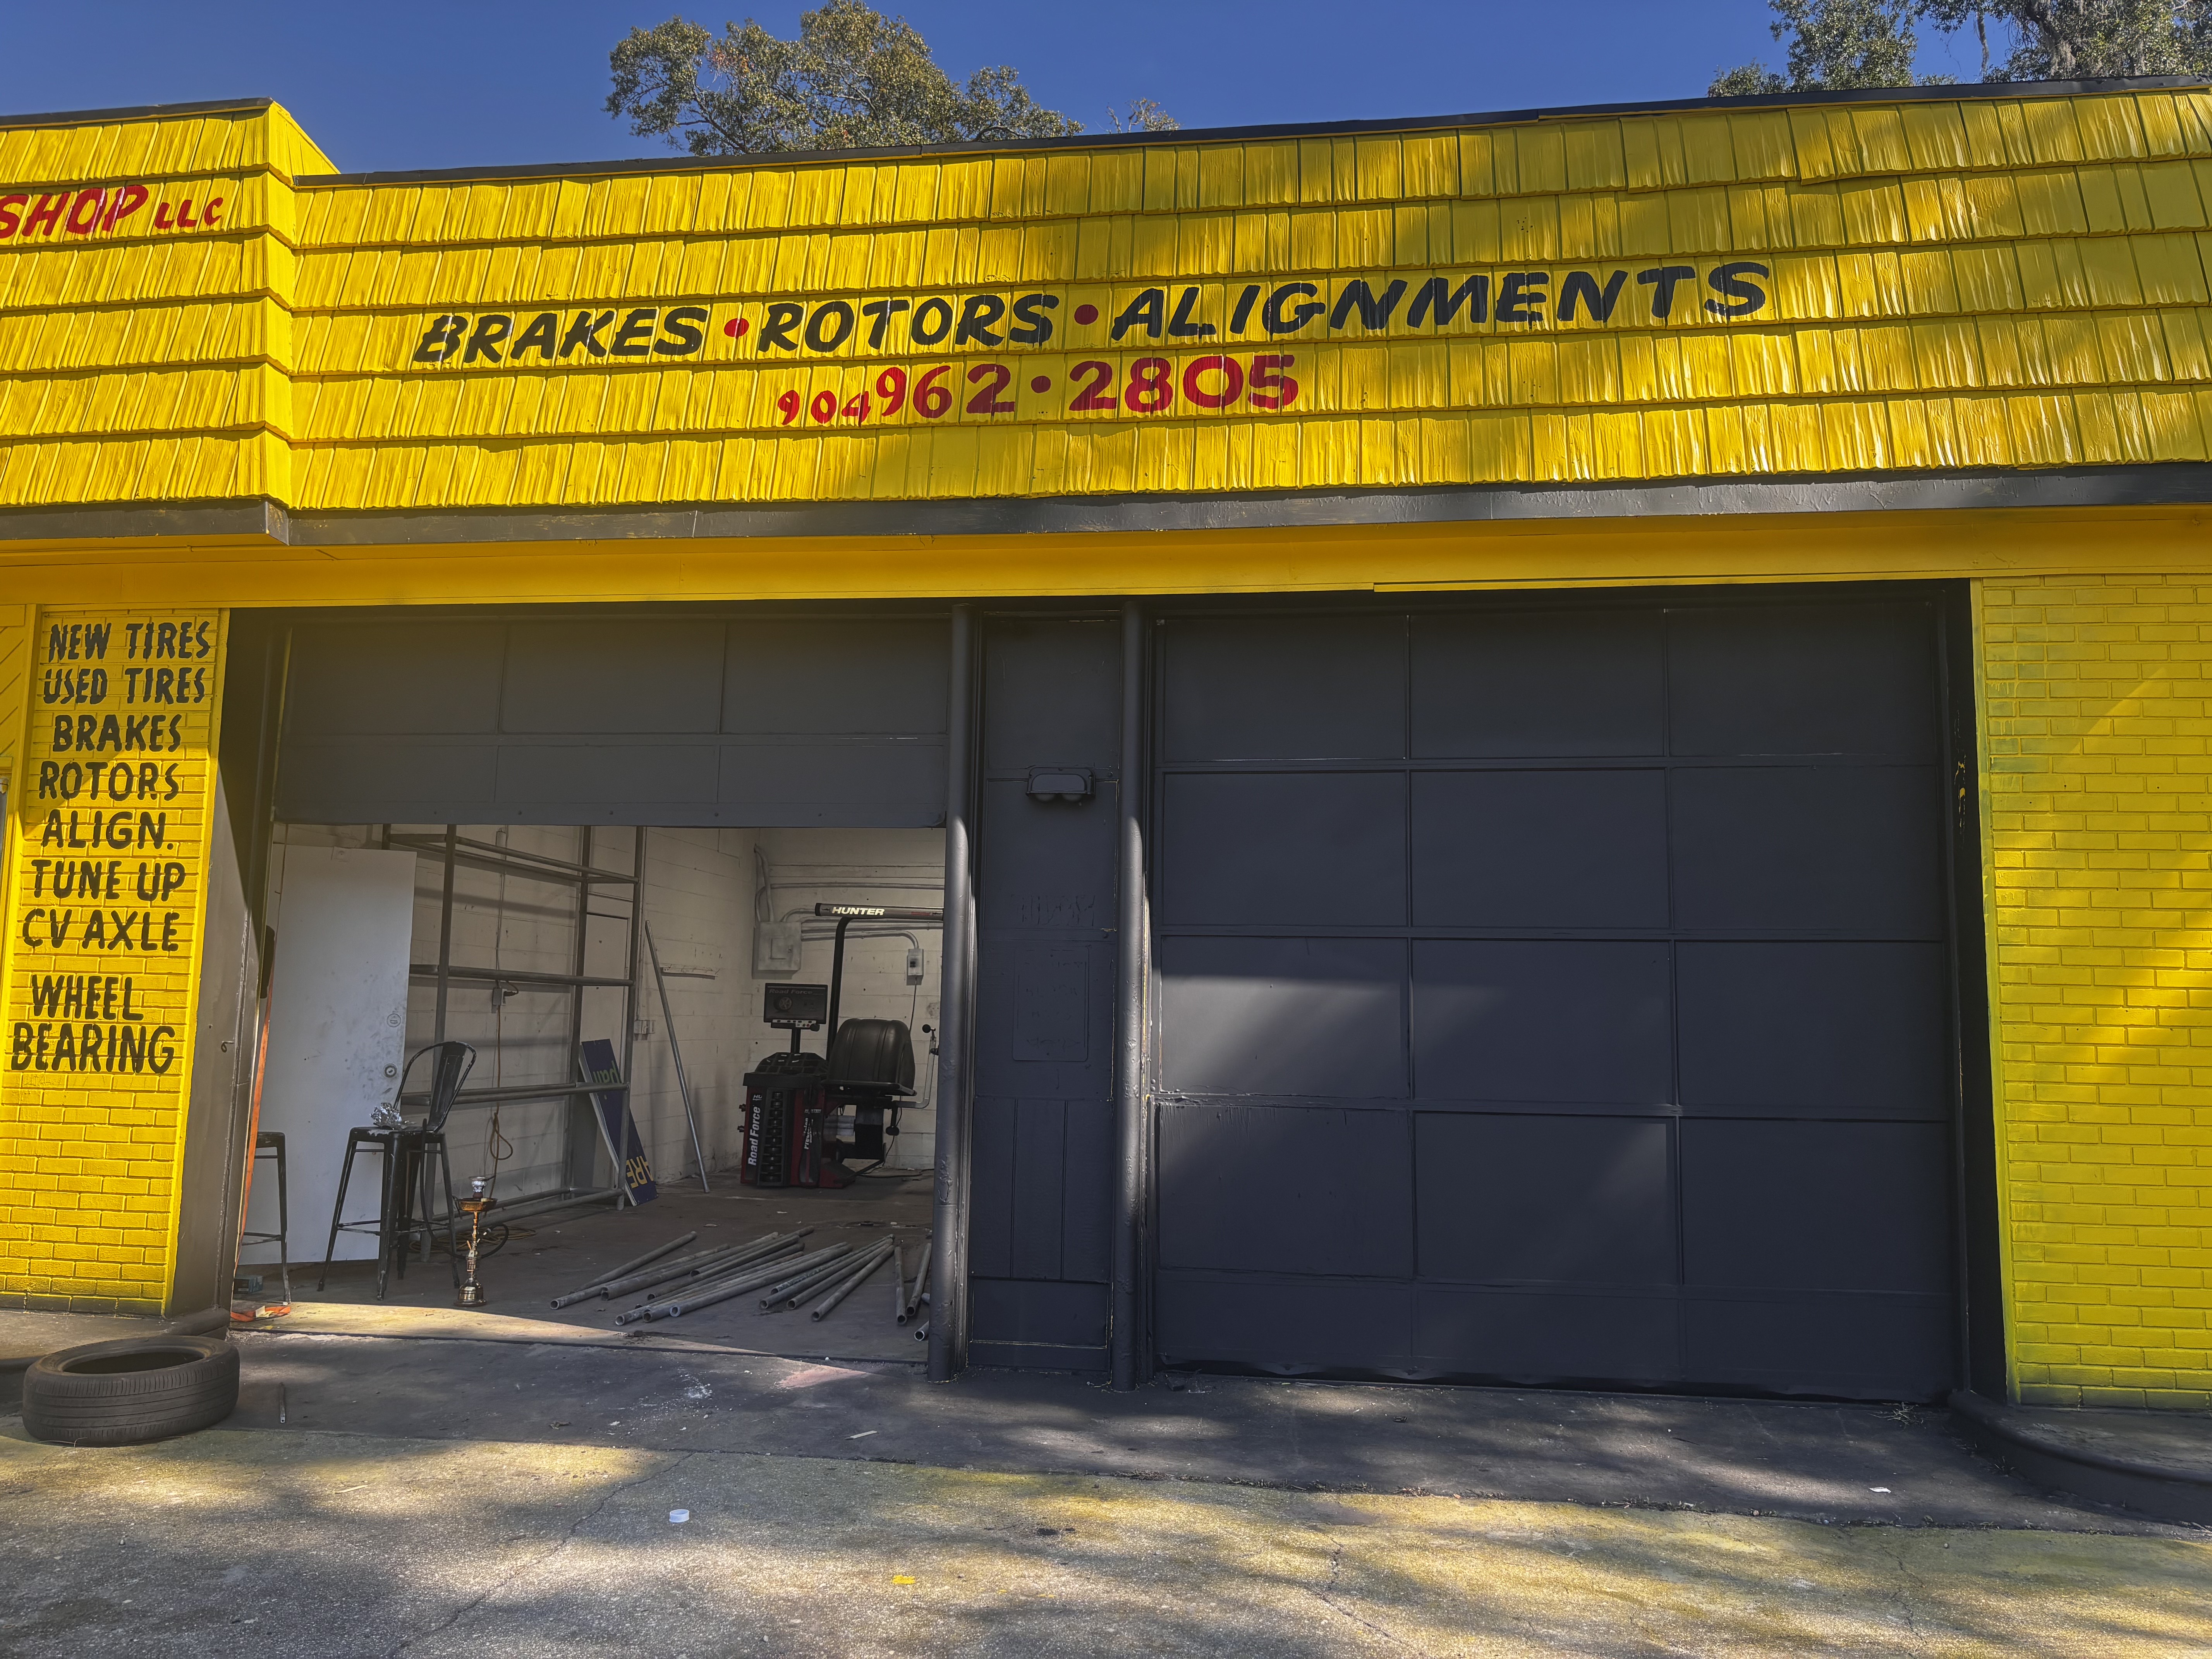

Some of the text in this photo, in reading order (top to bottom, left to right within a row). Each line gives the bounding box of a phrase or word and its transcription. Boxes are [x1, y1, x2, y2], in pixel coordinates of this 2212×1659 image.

[0, 185, 223, 239] SHOP LLC
[414, 262, 1769, 363] BRAKES ROTORS ALIGNMENTS
[49, 621, 210, 662] NEW TIRES
[43, 667, 206, 704] USED TIRES
[52, 714, 182, 752] BRAKES
[39, 761, 179, 801] ROTORS
[41, 809, 174, 850] ALIGN.
[31, 859, 185, 902] TUNE UP
[23, 908, 180, 951] CV AXLE
[832, 907, 885, 915] HUNTER
[32, 974, 144, 1021] WHEEL
[11, 1022, 175, 1074] BEARING
[748, 1106, 761, 1166] Road Force
